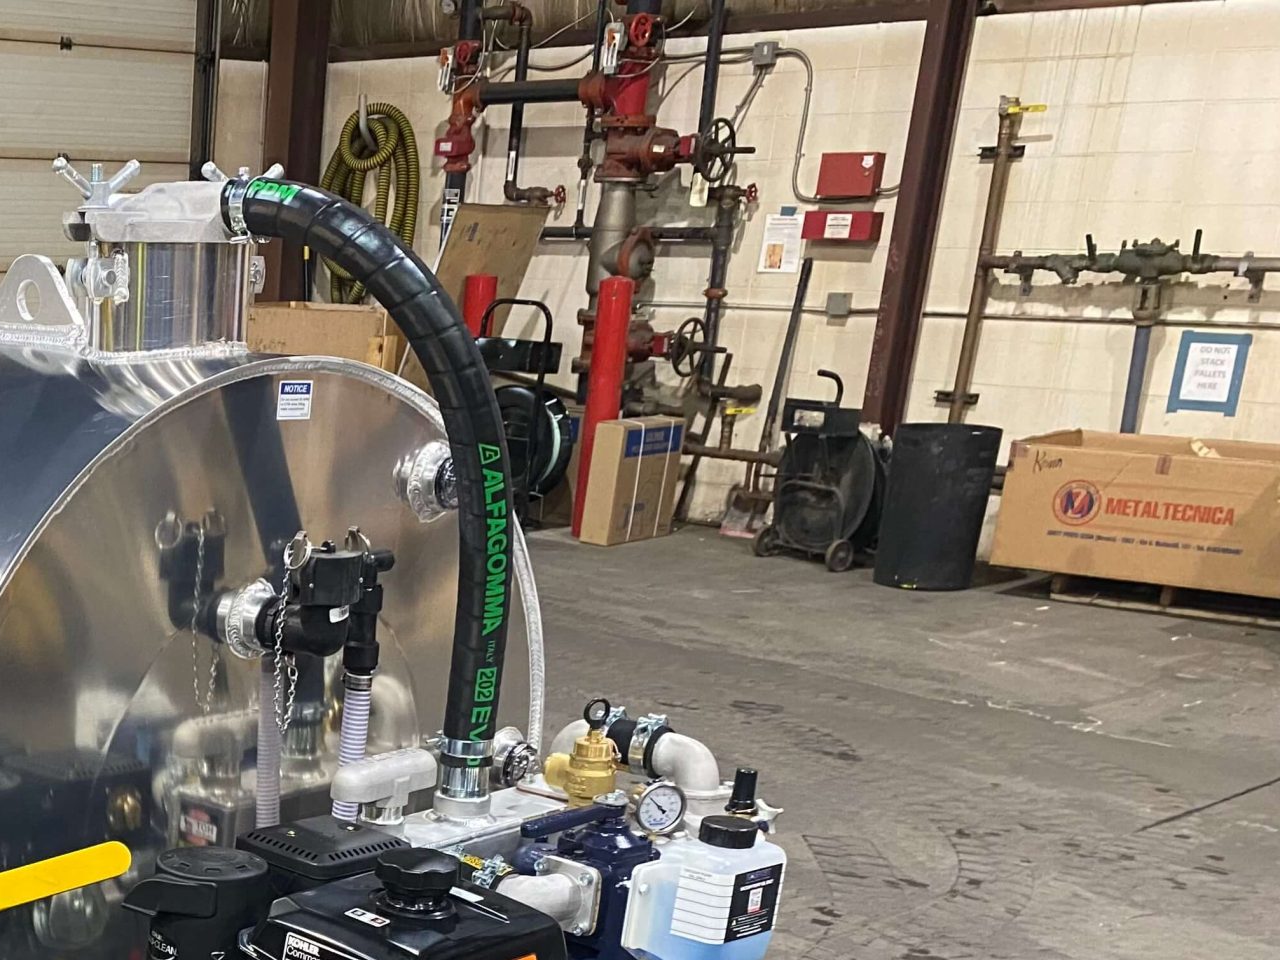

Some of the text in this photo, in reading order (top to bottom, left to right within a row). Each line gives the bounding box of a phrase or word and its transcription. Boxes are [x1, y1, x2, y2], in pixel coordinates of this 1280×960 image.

[283, 384, 308, 393] NOTICE
[1104, 497, 1235, 527] METALTECNICA
[482, 467, 507, 637] ALFAGOMMA
[485, 639, 496, 663] ITALY
[476, 668, 495, 700] 202
[287, 936, 320, 957] KOHLER
